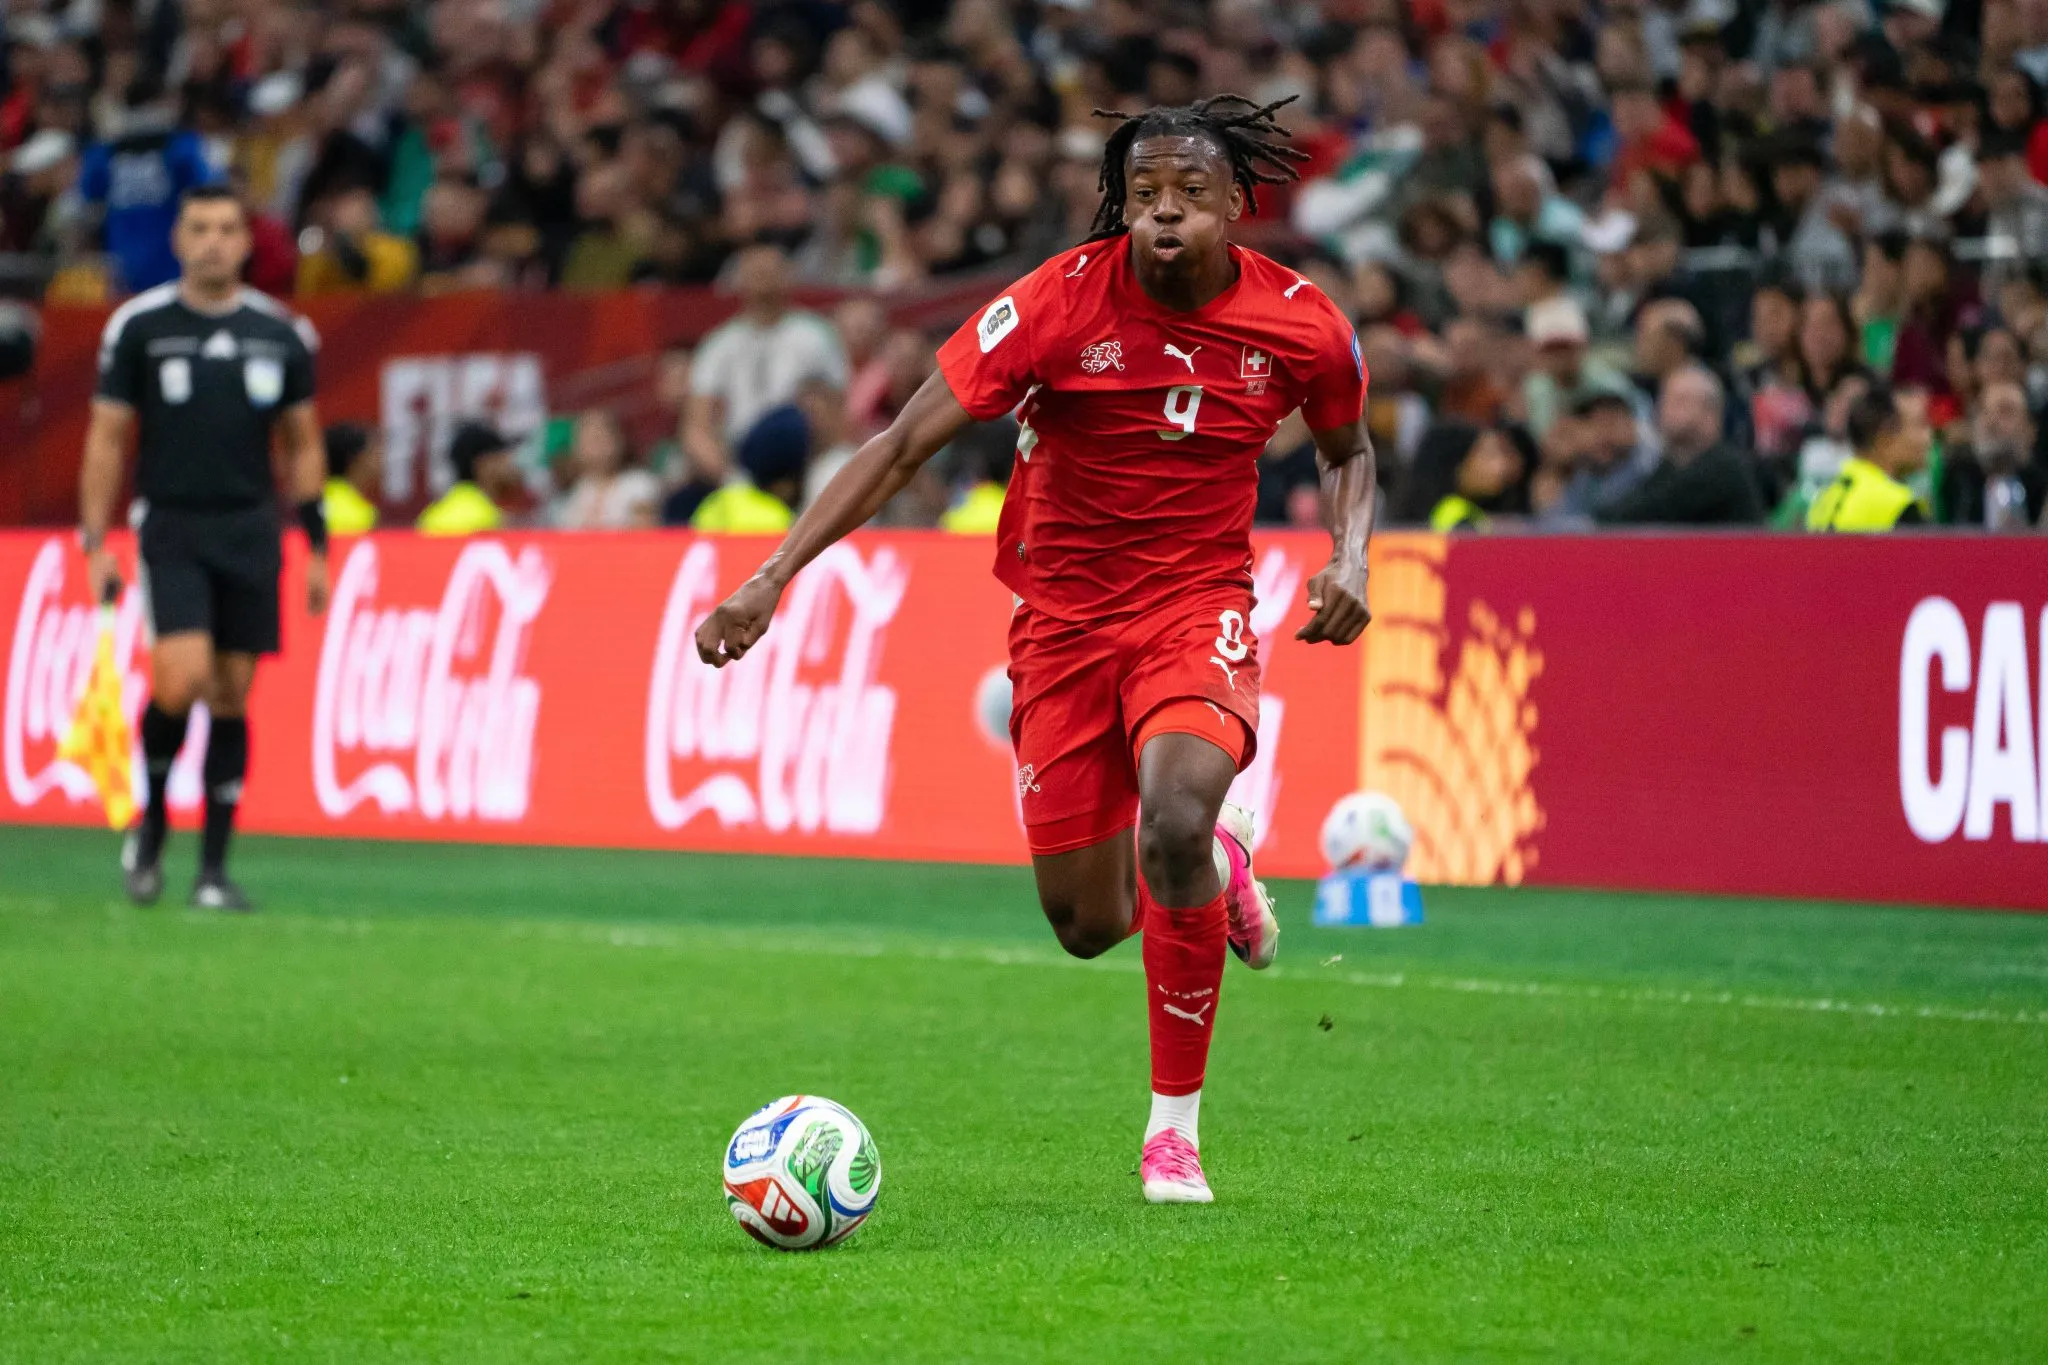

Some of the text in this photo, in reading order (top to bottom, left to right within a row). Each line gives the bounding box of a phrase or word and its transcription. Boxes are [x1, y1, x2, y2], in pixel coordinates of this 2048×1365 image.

[1156, 385, 1204, 441] 9
[1215, 609, 1248, 661] 9
[1899, 596, 2048, 843] CA
